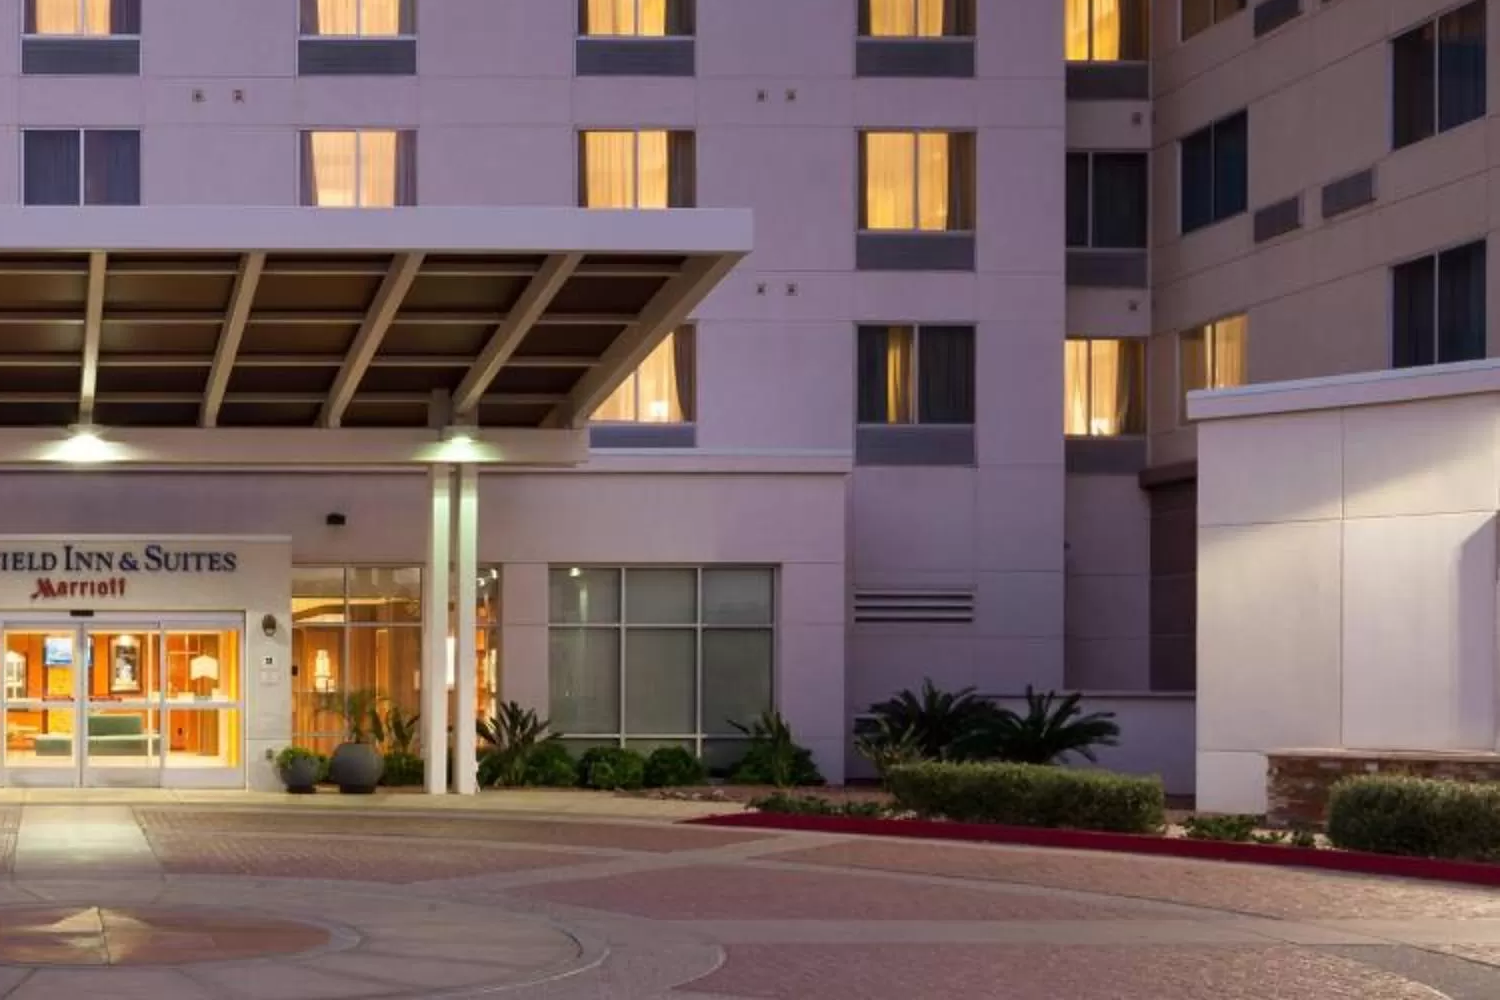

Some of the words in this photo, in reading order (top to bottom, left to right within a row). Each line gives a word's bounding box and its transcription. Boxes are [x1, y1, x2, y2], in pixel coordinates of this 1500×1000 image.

[64, 544, 113, 571] INN
[119, 551, 140, 571] &
[144, 544, 237, 572] SUITES
[30, 577, 126, 599] Marriott
